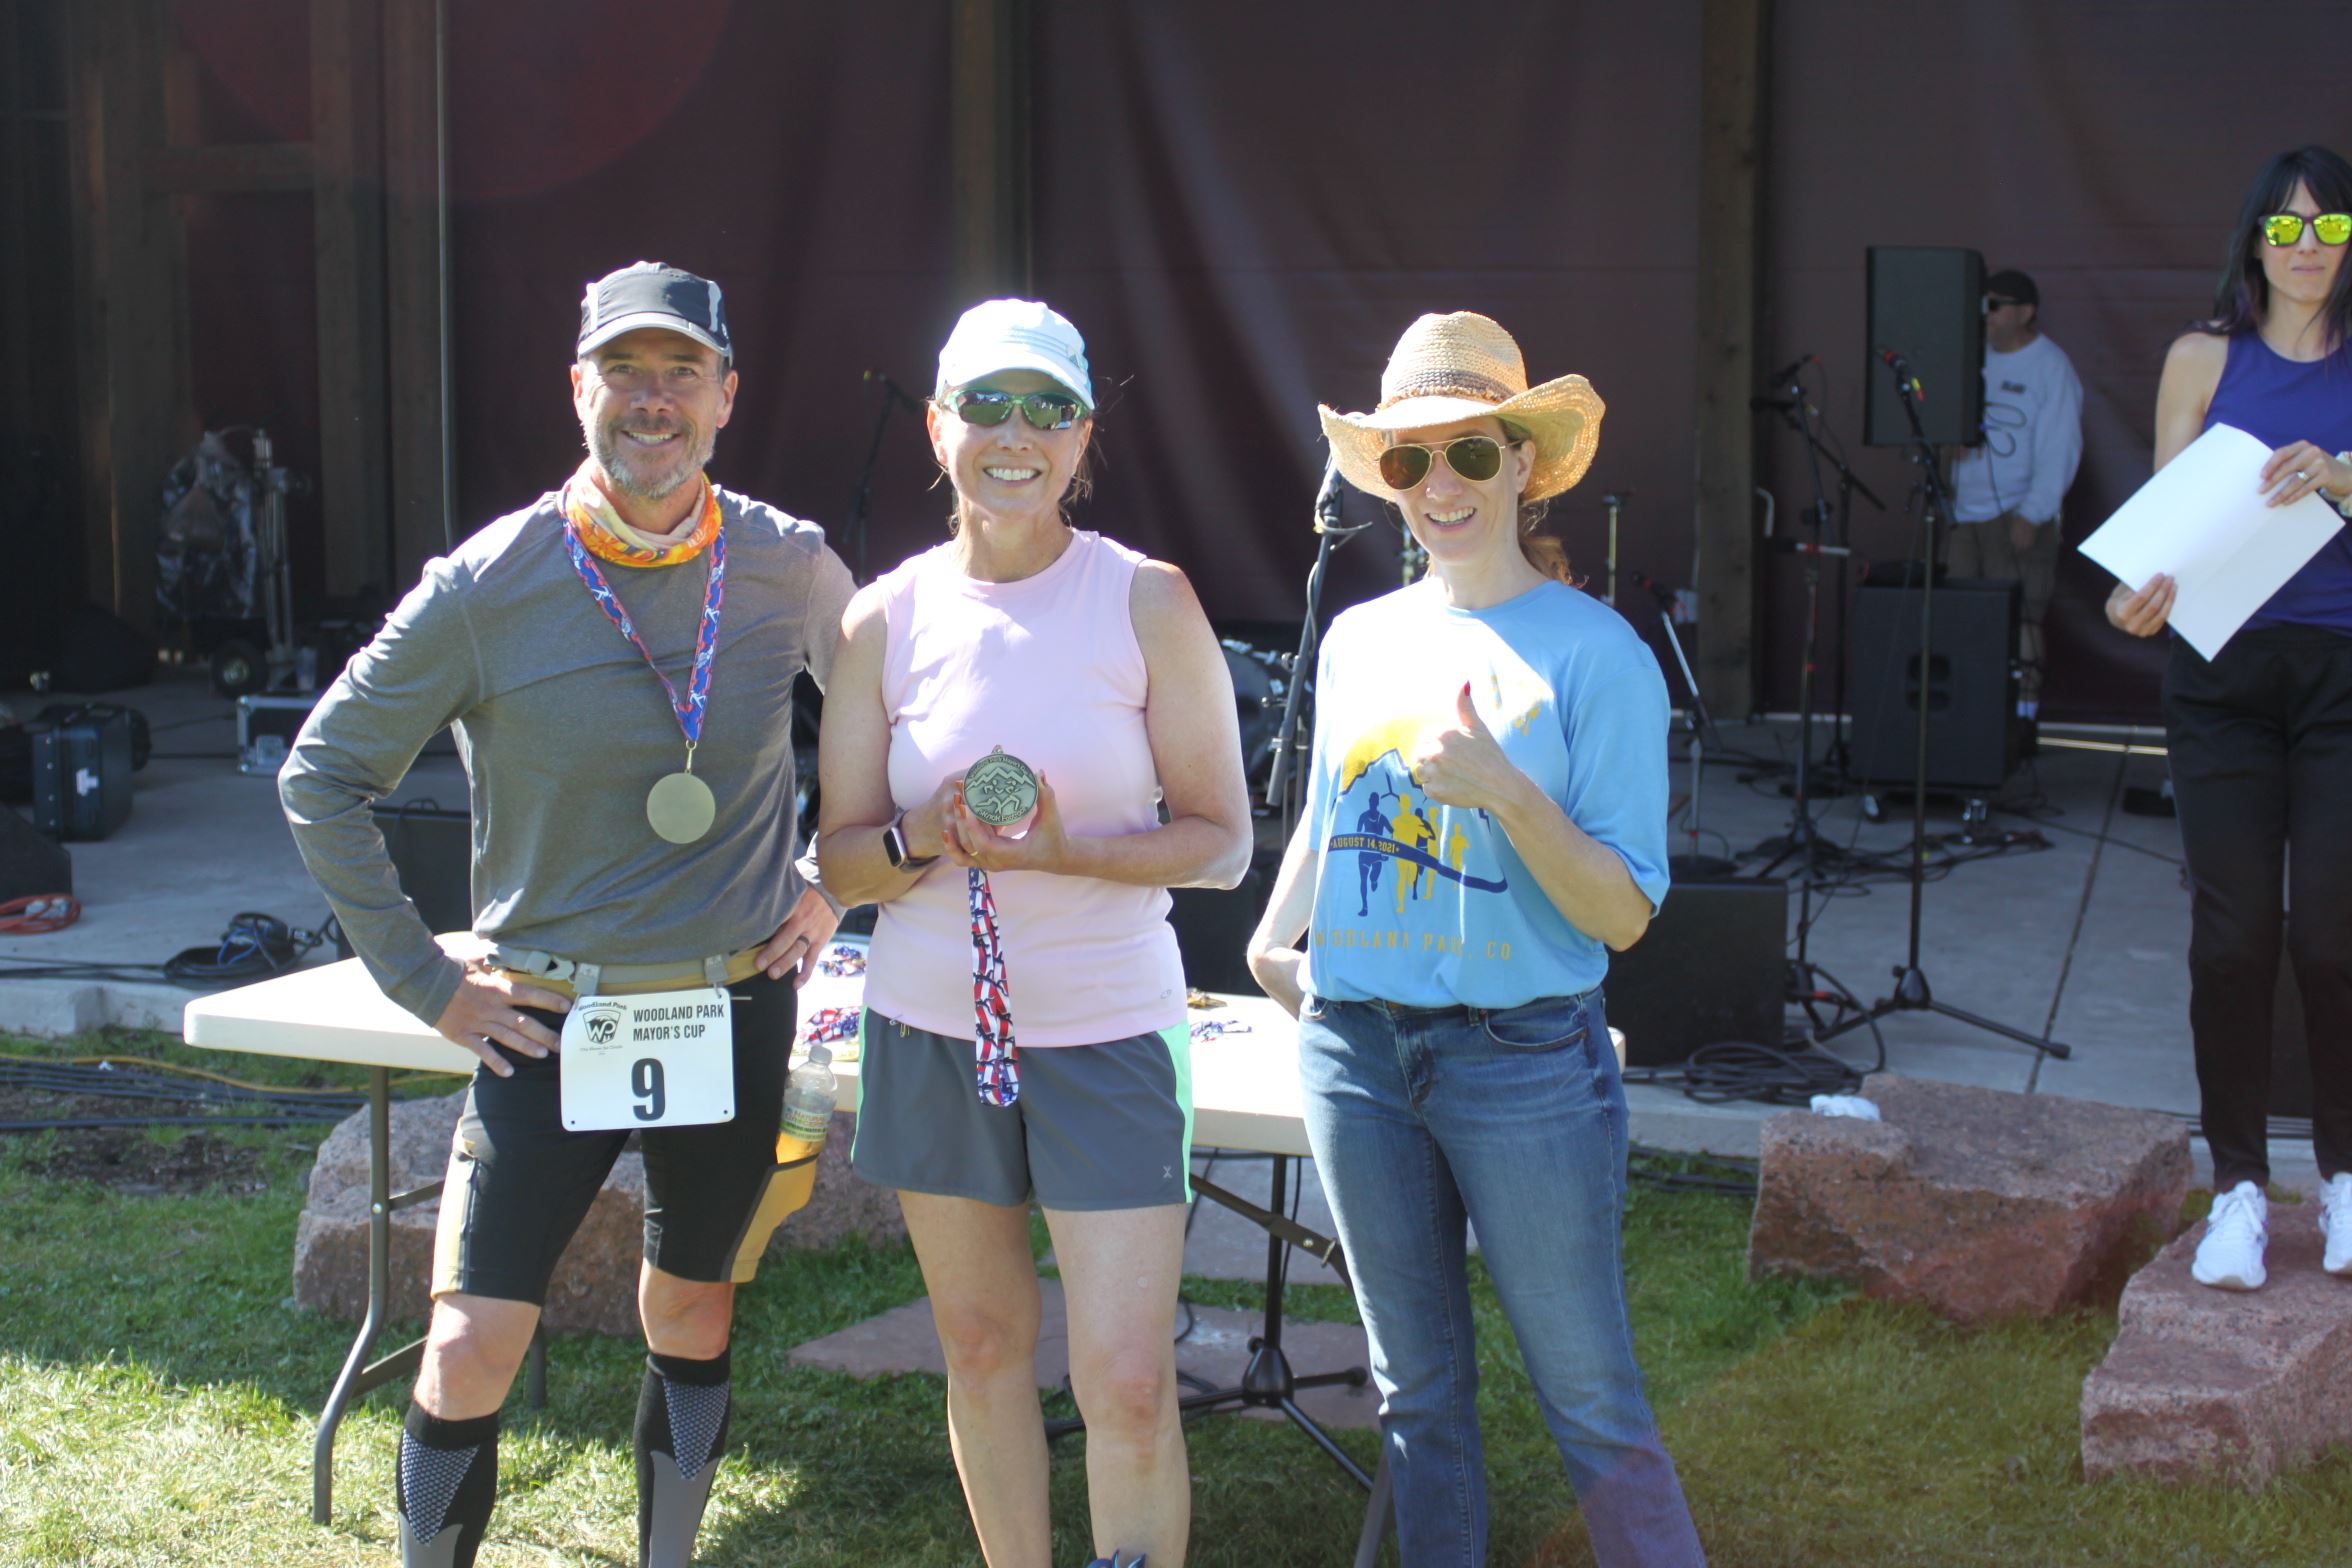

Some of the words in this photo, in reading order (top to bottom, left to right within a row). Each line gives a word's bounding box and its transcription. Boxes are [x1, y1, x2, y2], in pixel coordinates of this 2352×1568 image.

[1332, 837, 1364, 848] AUGUST
[1315, 930, 1409, 949] WODLAN
[1486, 941, 1511, 960] CO
[633, 1006, 693, 1023] WOODLAND
[696, 1004, 725, 1019] PARK
[633, 1026, 681, 1042] MAYOR'S
[684, 1025, 706, 1038] CUP
[631, 1057, 666, 1122] 9
